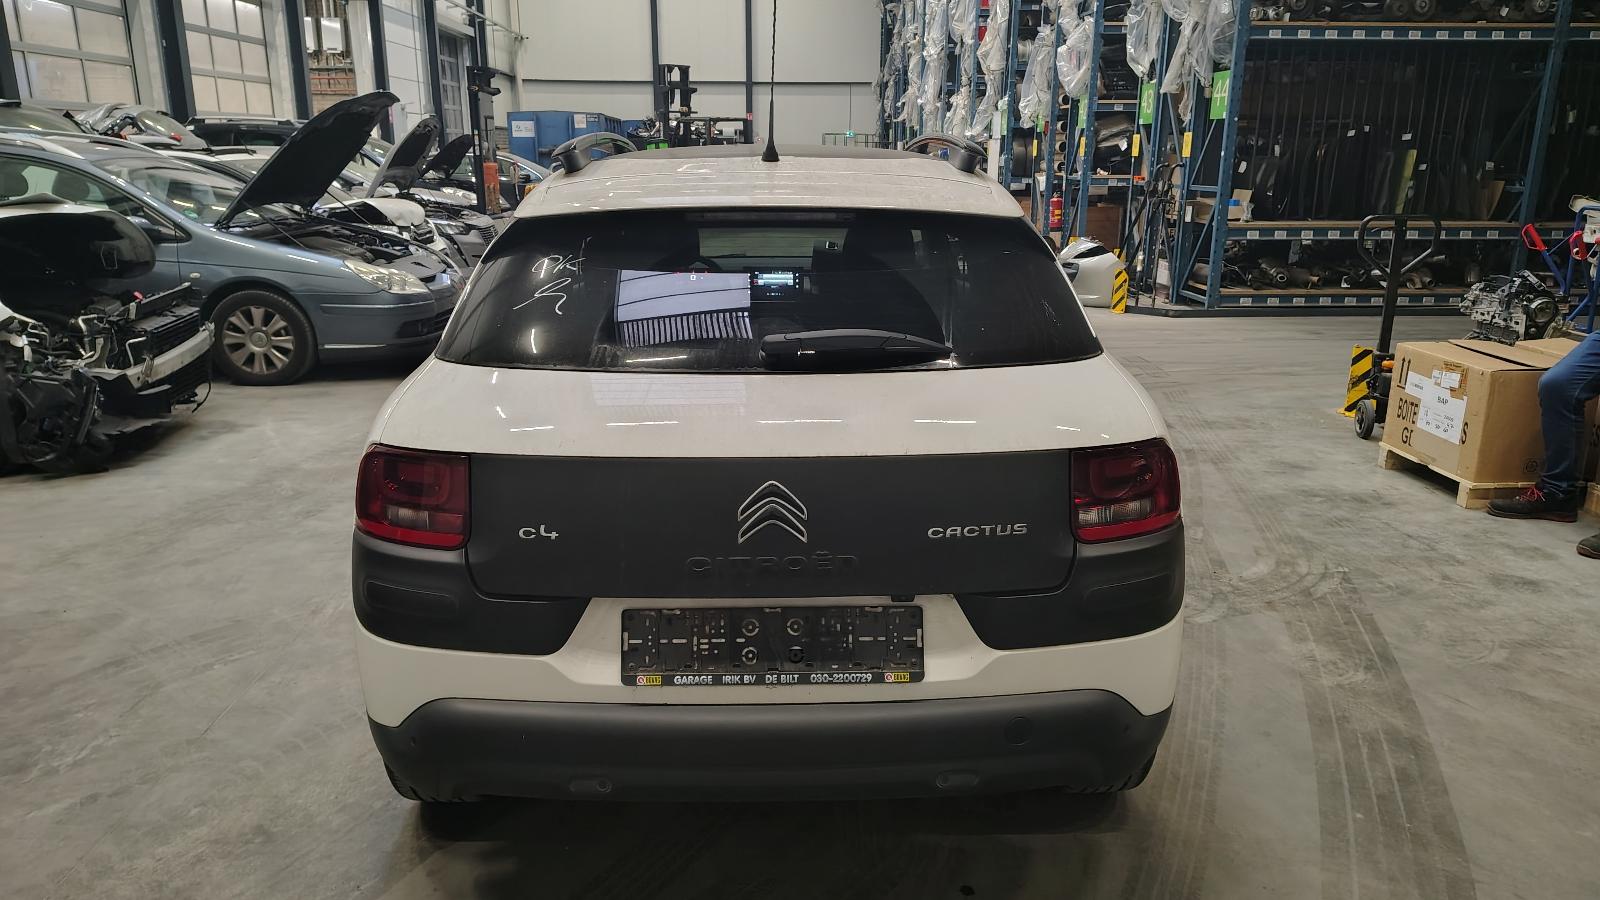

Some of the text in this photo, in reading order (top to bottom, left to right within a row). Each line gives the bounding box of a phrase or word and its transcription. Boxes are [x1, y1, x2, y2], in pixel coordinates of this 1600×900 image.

[1213, 78, 1230, 106] 44
[1142, 90, 1154, 114] 43
[518, 524, 559, 540] C4
[927, 523, 1028, 538] CACTUS
[673, 673, 873, 685] GARAGE IRIK BV DE BILT 030-2200729
